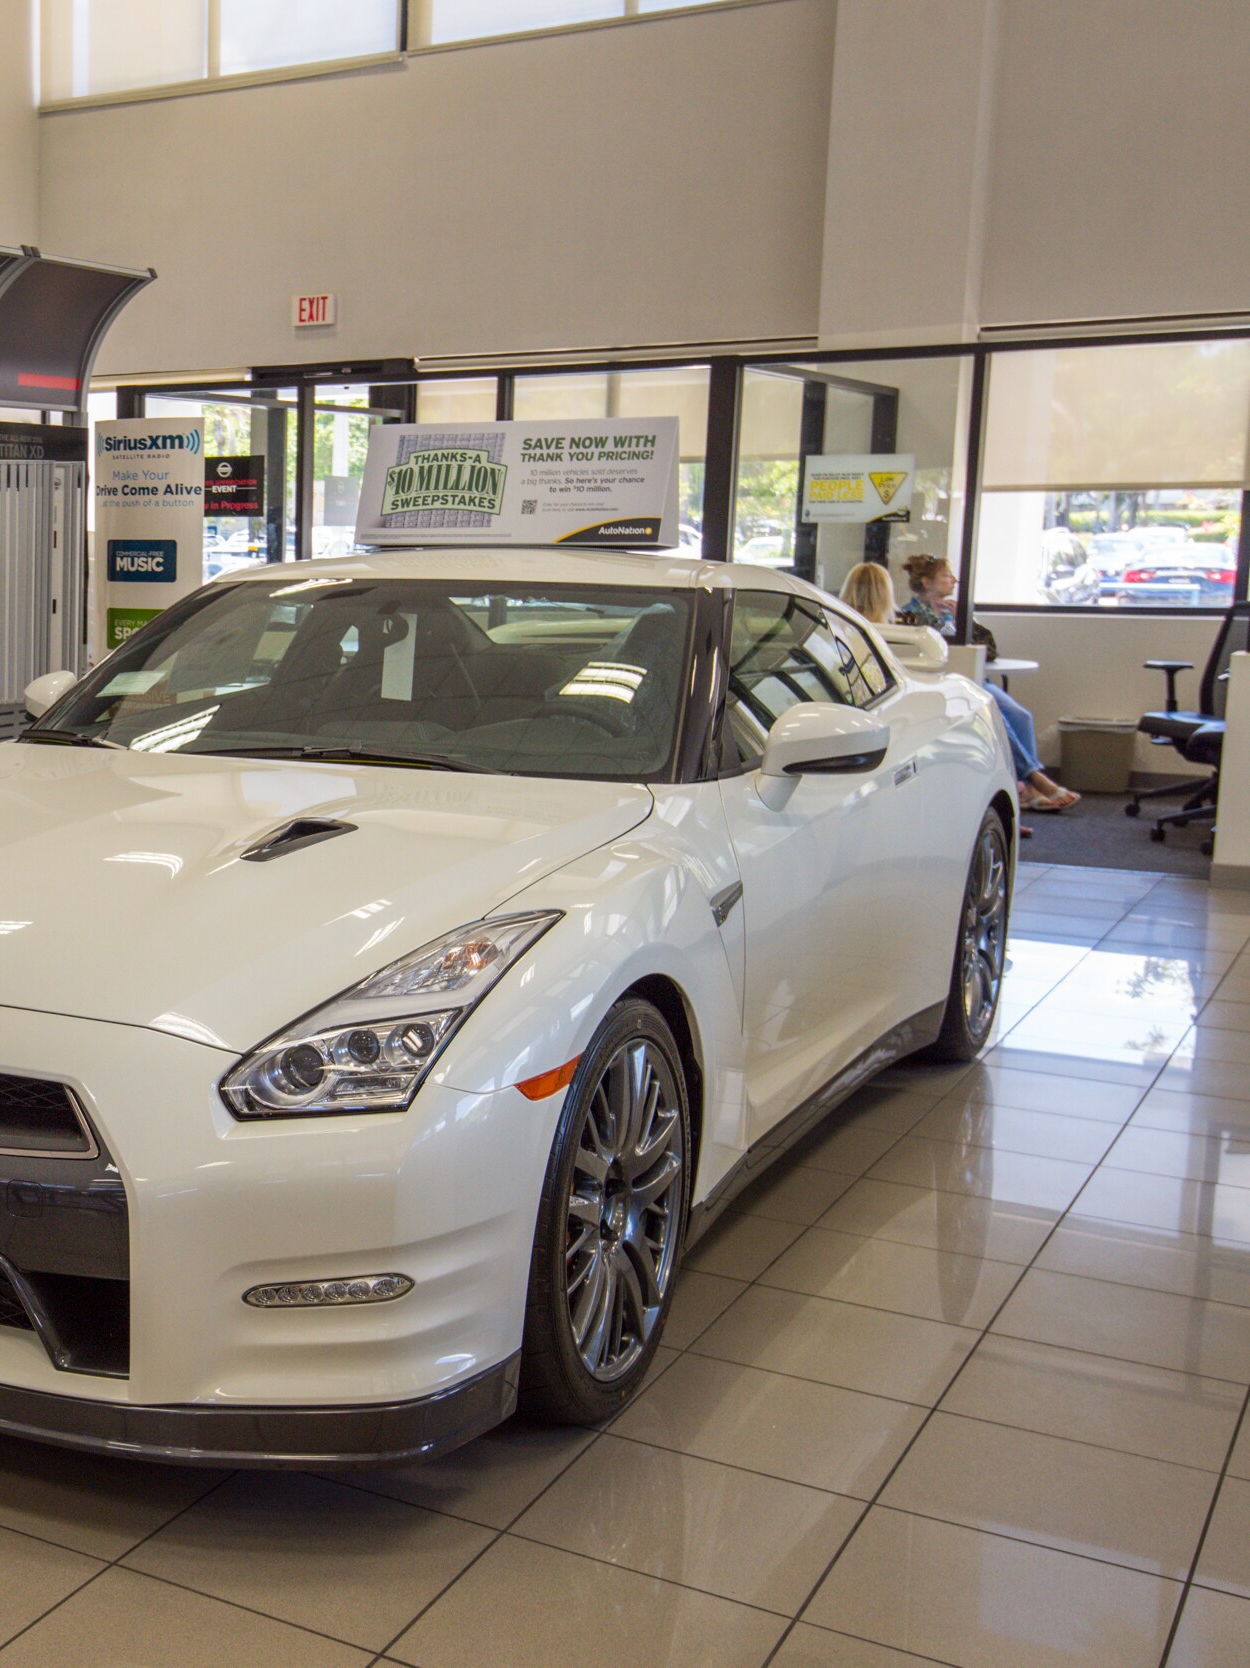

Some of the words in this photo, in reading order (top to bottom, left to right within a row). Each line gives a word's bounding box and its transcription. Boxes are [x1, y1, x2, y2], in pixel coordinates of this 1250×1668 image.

[299, 296, 328, 323] EXIT
[522, 437, 566, 450] SAVE
[569, 436, 608, 449] NOW
[613, 435, 656, 448] WITH
[30, 445, 44, 459] XD
[521, 452, 564, 462] THANK
[568, 451, 594, 461] YOU
[598, 450, 654, 460] PRICING!
[414, 452, 481, 465] THANKS-A
[112, 471, 139, 481] Make
[142, 470, 170, 481] Your
[562, 468, 589, 476] vehicles
[415, 464, 503, 497] MILLION
[526, 478, 537, 486] big
[576, 476, 598, 484] here's
[600, 477, 616, 486] your
[810, 480, 864, 492] PEOPLE
[121, 485, 159, 496] Come
[163, 483, 202, 496] Alive
[212, 485, 237, 493] EVENT
[122, 500, 141, 509] push
[143, 499, 152, 508] of
[162, 499, 194, 507] button
[221, 500, 259, 511] Progress
[390, 493, 496, 511] SWEEPSTAKES
[598, 526, 645, 535] AutoNation
[115, 556, 165, 572] MUSIC
